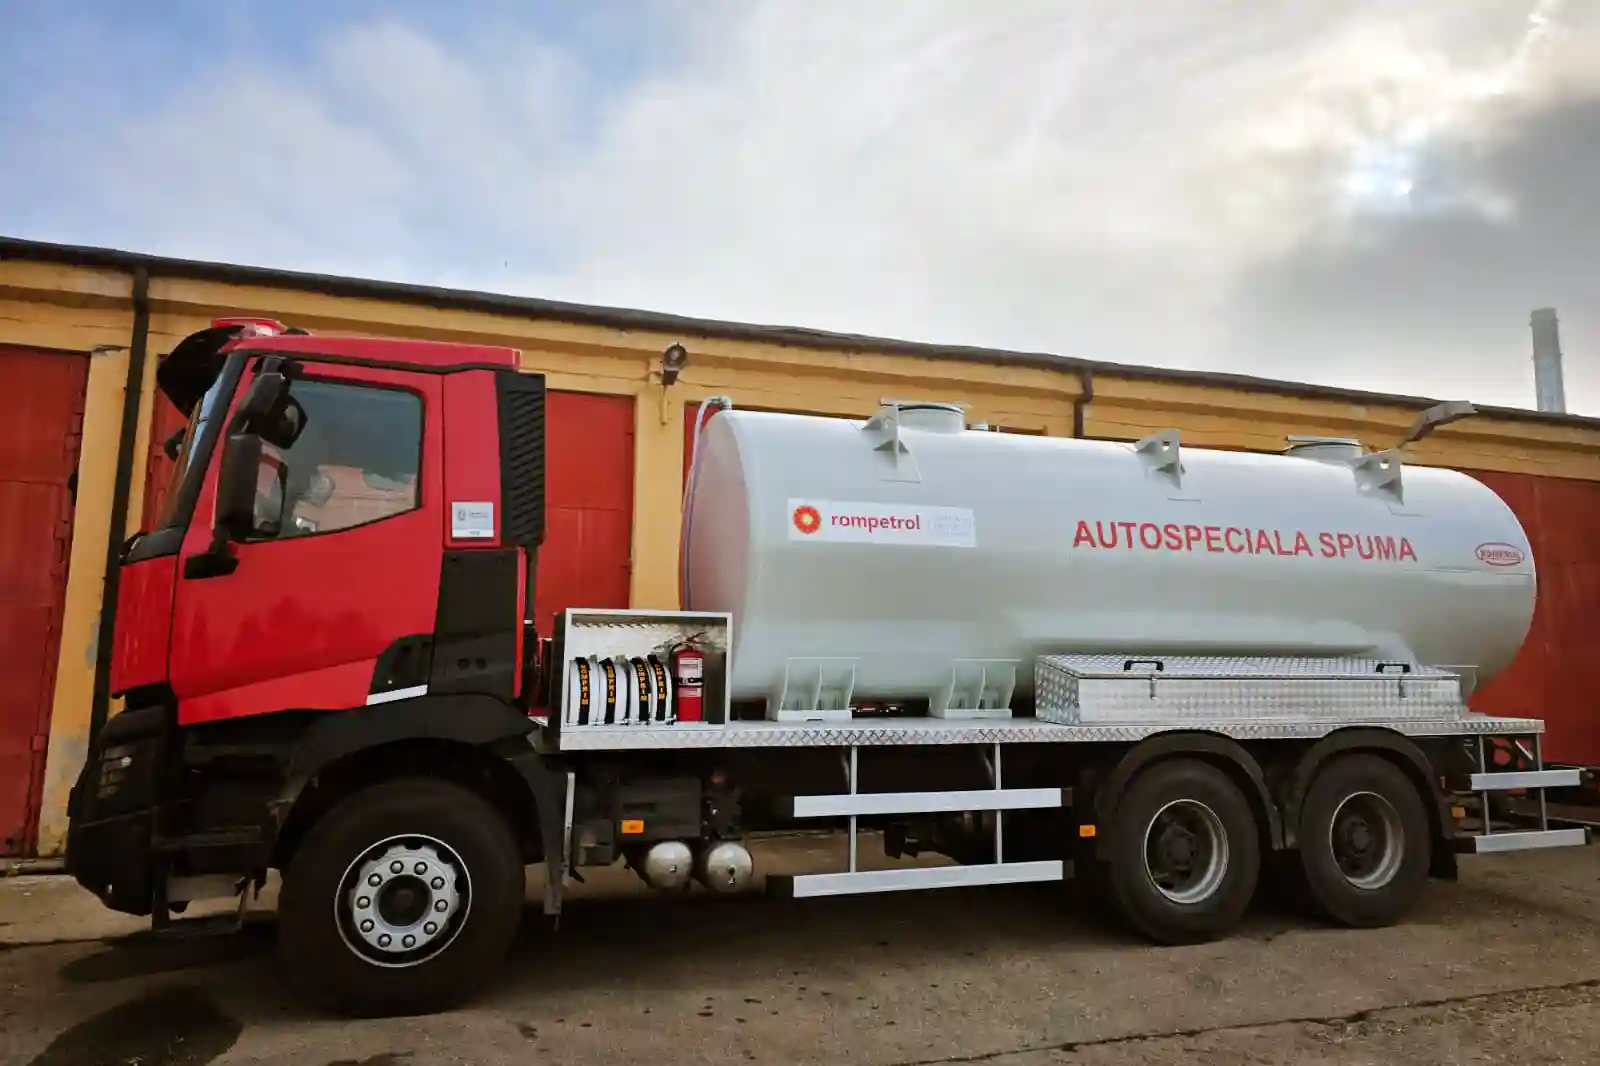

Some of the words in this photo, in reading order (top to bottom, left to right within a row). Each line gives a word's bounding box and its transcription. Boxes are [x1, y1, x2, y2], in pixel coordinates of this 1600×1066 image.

[831, 514, 921, 533] rompetrol
[1072, 520, 1313, 557] AUTOSPECIALA
[1318, 532, 1418, 563] SPUMA
